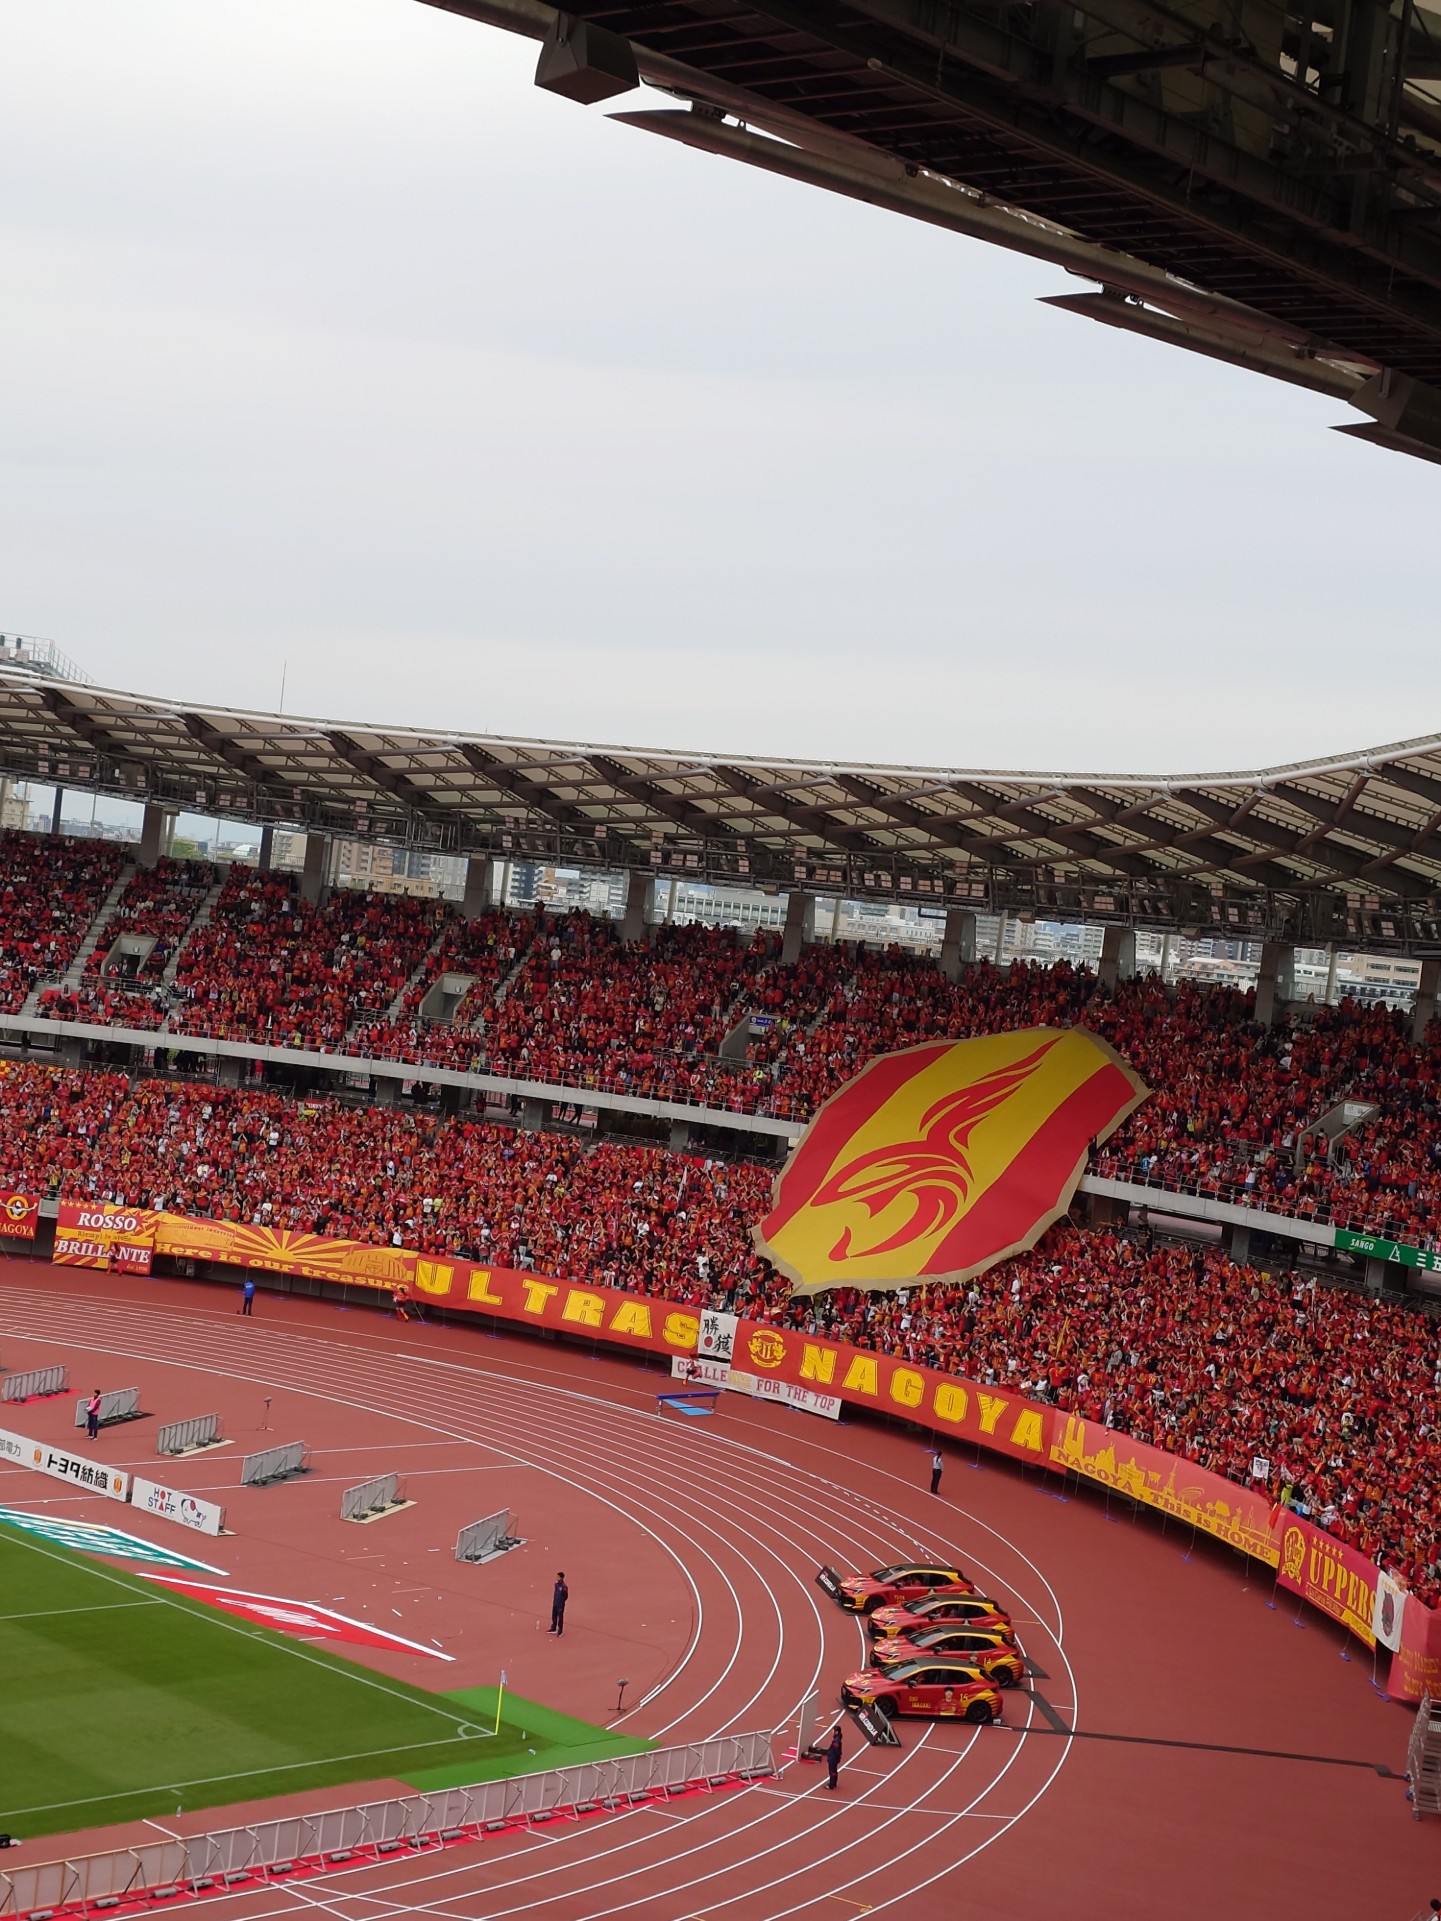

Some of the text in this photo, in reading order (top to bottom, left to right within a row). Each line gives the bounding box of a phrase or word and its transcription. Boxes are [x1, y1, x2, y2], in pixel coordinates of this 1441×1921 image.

[0, 1223, 34, 1236] AGOYA
[77, 1211, 137, 1231] ROSSO
[1350, 1238, 1374, 1251] SANGO
[156, 1243, 410, 1291] Here is our treasure
[415, 1259, 699, 1348] ULTRAS
[756, 1379, 780, 1396] FOR
[785, 1385, 808, 1404] THE
[814, 1394, 834, 1411] TOP
[799, 1343, 1044, 1452] NAGOYA
[46, 1453, 109, 1490] トヨタ紡織
[148, 1496, 176, 1514] STAFF
[153, 1487, 172, 1501] HOT
[1150, 1490, 1191, 1520] This
[1196, 1512, 1212, 1531] is
[1216, 1522, 1272, 1560] HOME
